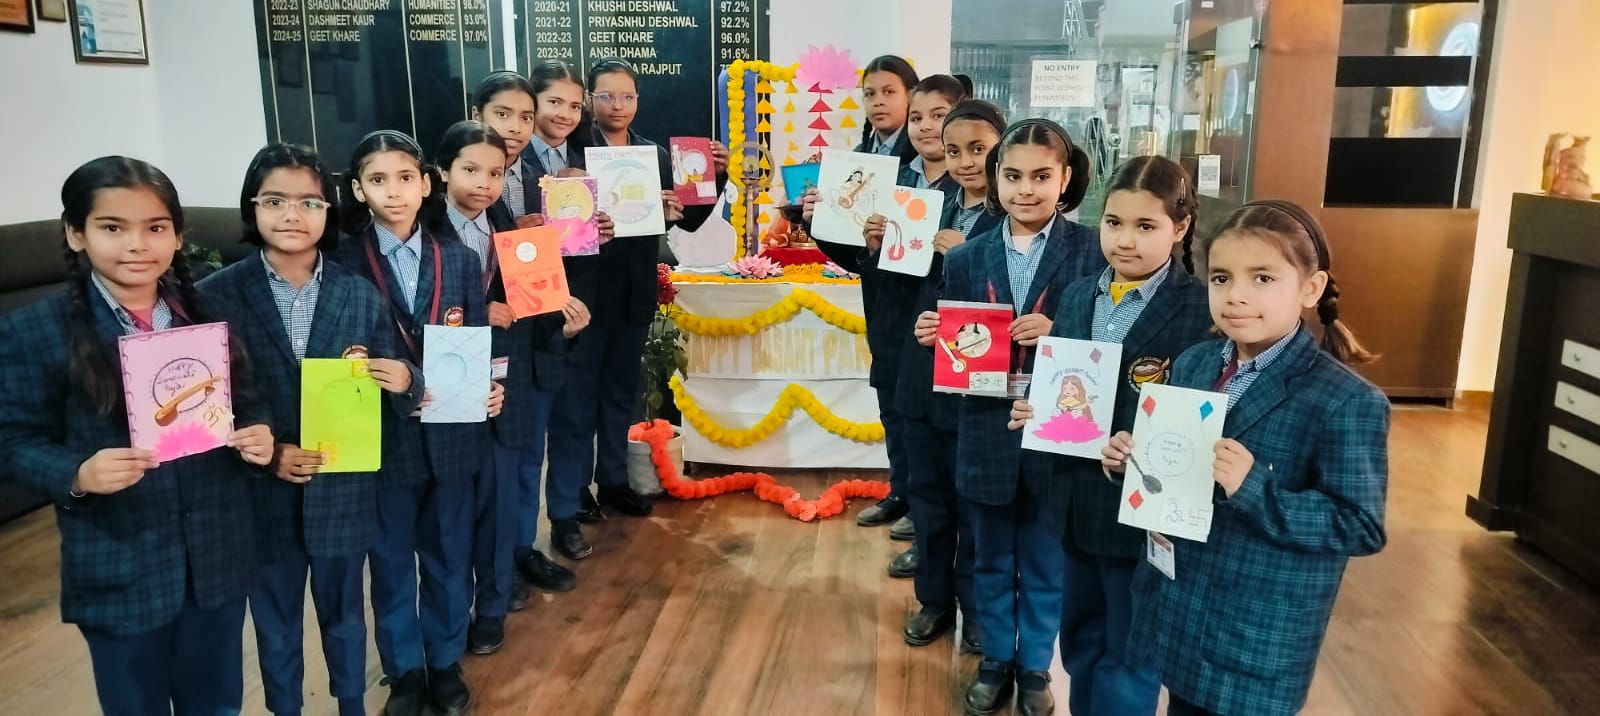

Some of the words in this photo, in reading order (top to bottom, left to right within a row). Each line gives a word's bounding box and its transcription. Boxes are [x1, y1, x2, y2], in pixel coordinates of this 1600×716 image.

[272, 0, 298, 10] 2022-23
[308, 0, 339, 10] SHAGUN
[342, 0, 390, 10] CHAUDHARY
[408, 0, 456, 9] HUMANITIES
[535, 1, 570, 12] 2020-21
[588, 1, 626, 12] KHUSHI
[629, 1, 679, 12] DESHWAL
[720, 1, 750, 12] 97.2%
[272, 14, 300, 25] 2023-24
[309, 14, 350, 25] DASHMEET
[352, 14, 375, 25] KAUR
[409, 14, 455, 25] COMMERCE
[464, 14, 487, 25] 93.0%
[535, 16, 571, 27] 2021-22
[588, 16, 646, 27] PRIYASNHU
[648, 16, 699, 27] DESHWAL
[720, 17, 750, 28] 92.2%
[272, 31, 301, 41] 2024-25
[311, 31, 330, 41] GEET
[332, 31, 360, 41] KHARE
[410, 30, 457, 41] COMMERCE
[464, 31, 488, 41] 97.0%
[536, 32, 572, 43] 2022-23
[589, 32, 616, 43] GEET
[618, 32, 654, 43] KHARE
[720, 32, 750, 44] 96.0%
[537, 47, 573, 58] 2023-24
[590, 47, 618, 58] ANSH
[620, 47, 657, 58] DHAMA
[721, 48, 750, 59] 91.6%
[641, 63, 682, 74] RAJPUT
